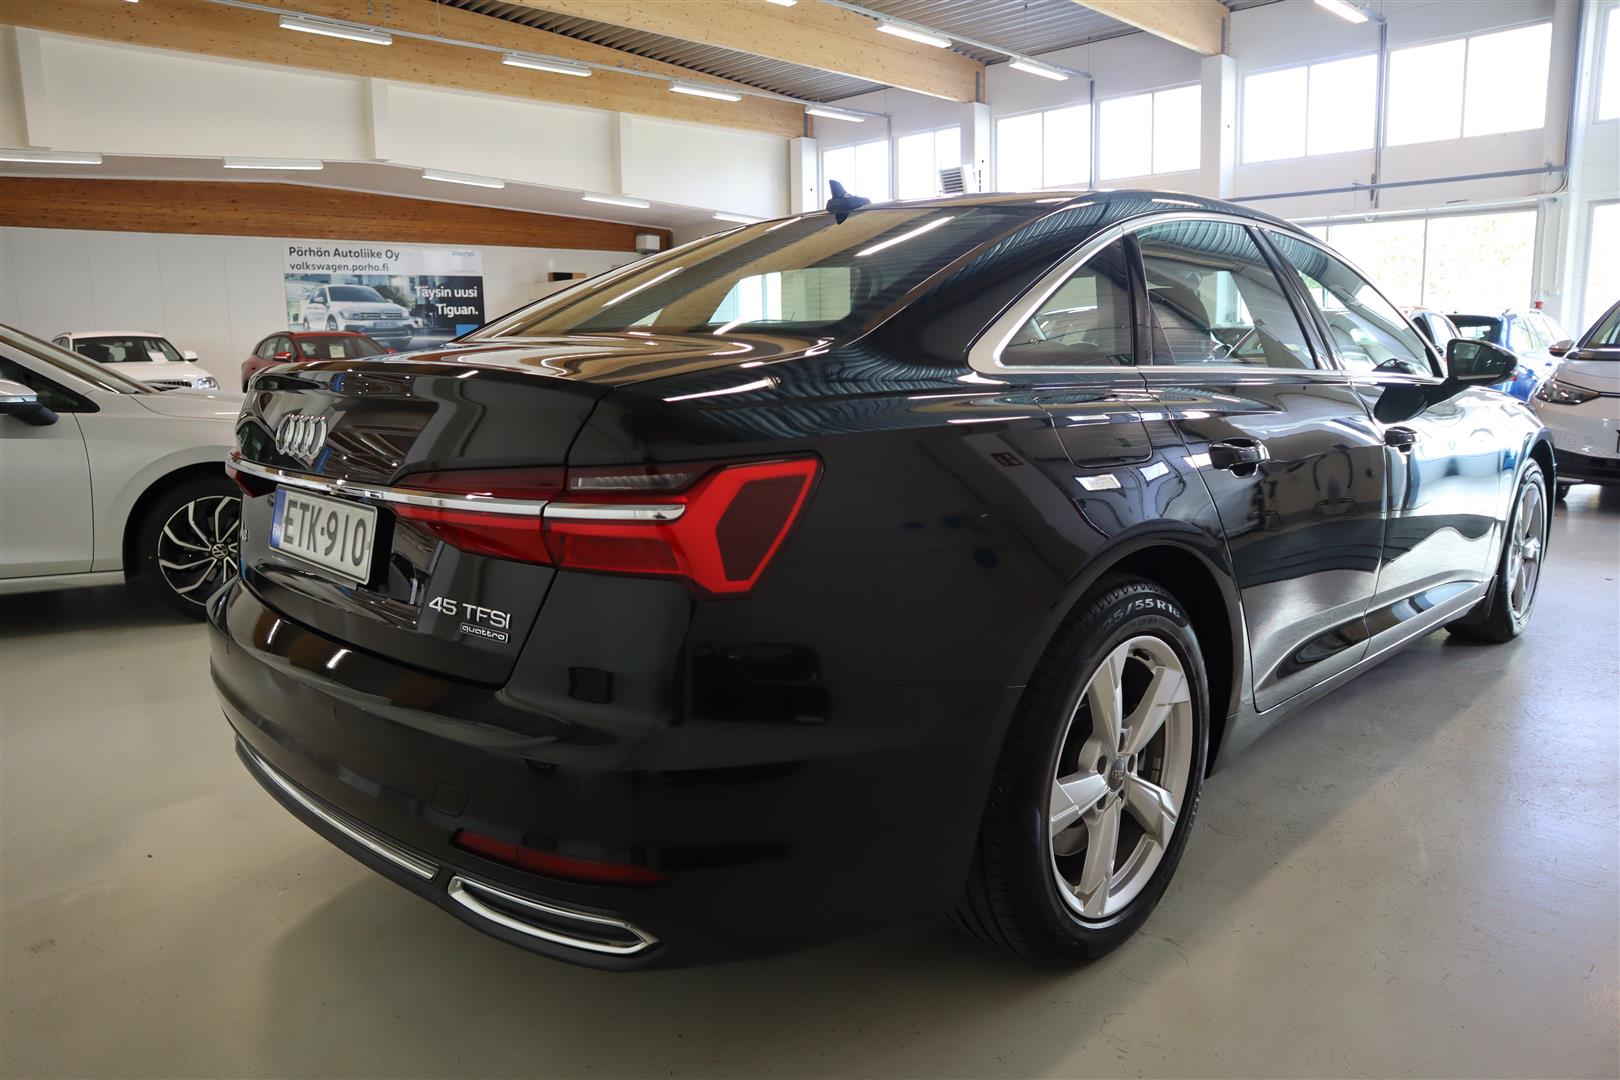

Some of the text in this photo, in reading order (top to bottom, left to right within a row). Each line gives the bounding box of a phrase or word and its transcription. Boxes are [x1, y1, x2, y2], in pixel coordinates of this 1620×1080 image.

[289, 246, 400, 261] Pörhön Autoliike Oy
[290, 261, 389, 272] volkswagen.porho.fi
[415, 285, 478, 300] Täysin uusi
[435, 303, 479, 318] Tiguan.
[283, 499, 367, 567] ETK-910
[428, 596, 511, 629] 45 TFSI
[461, 624, 507, 642] quattro
